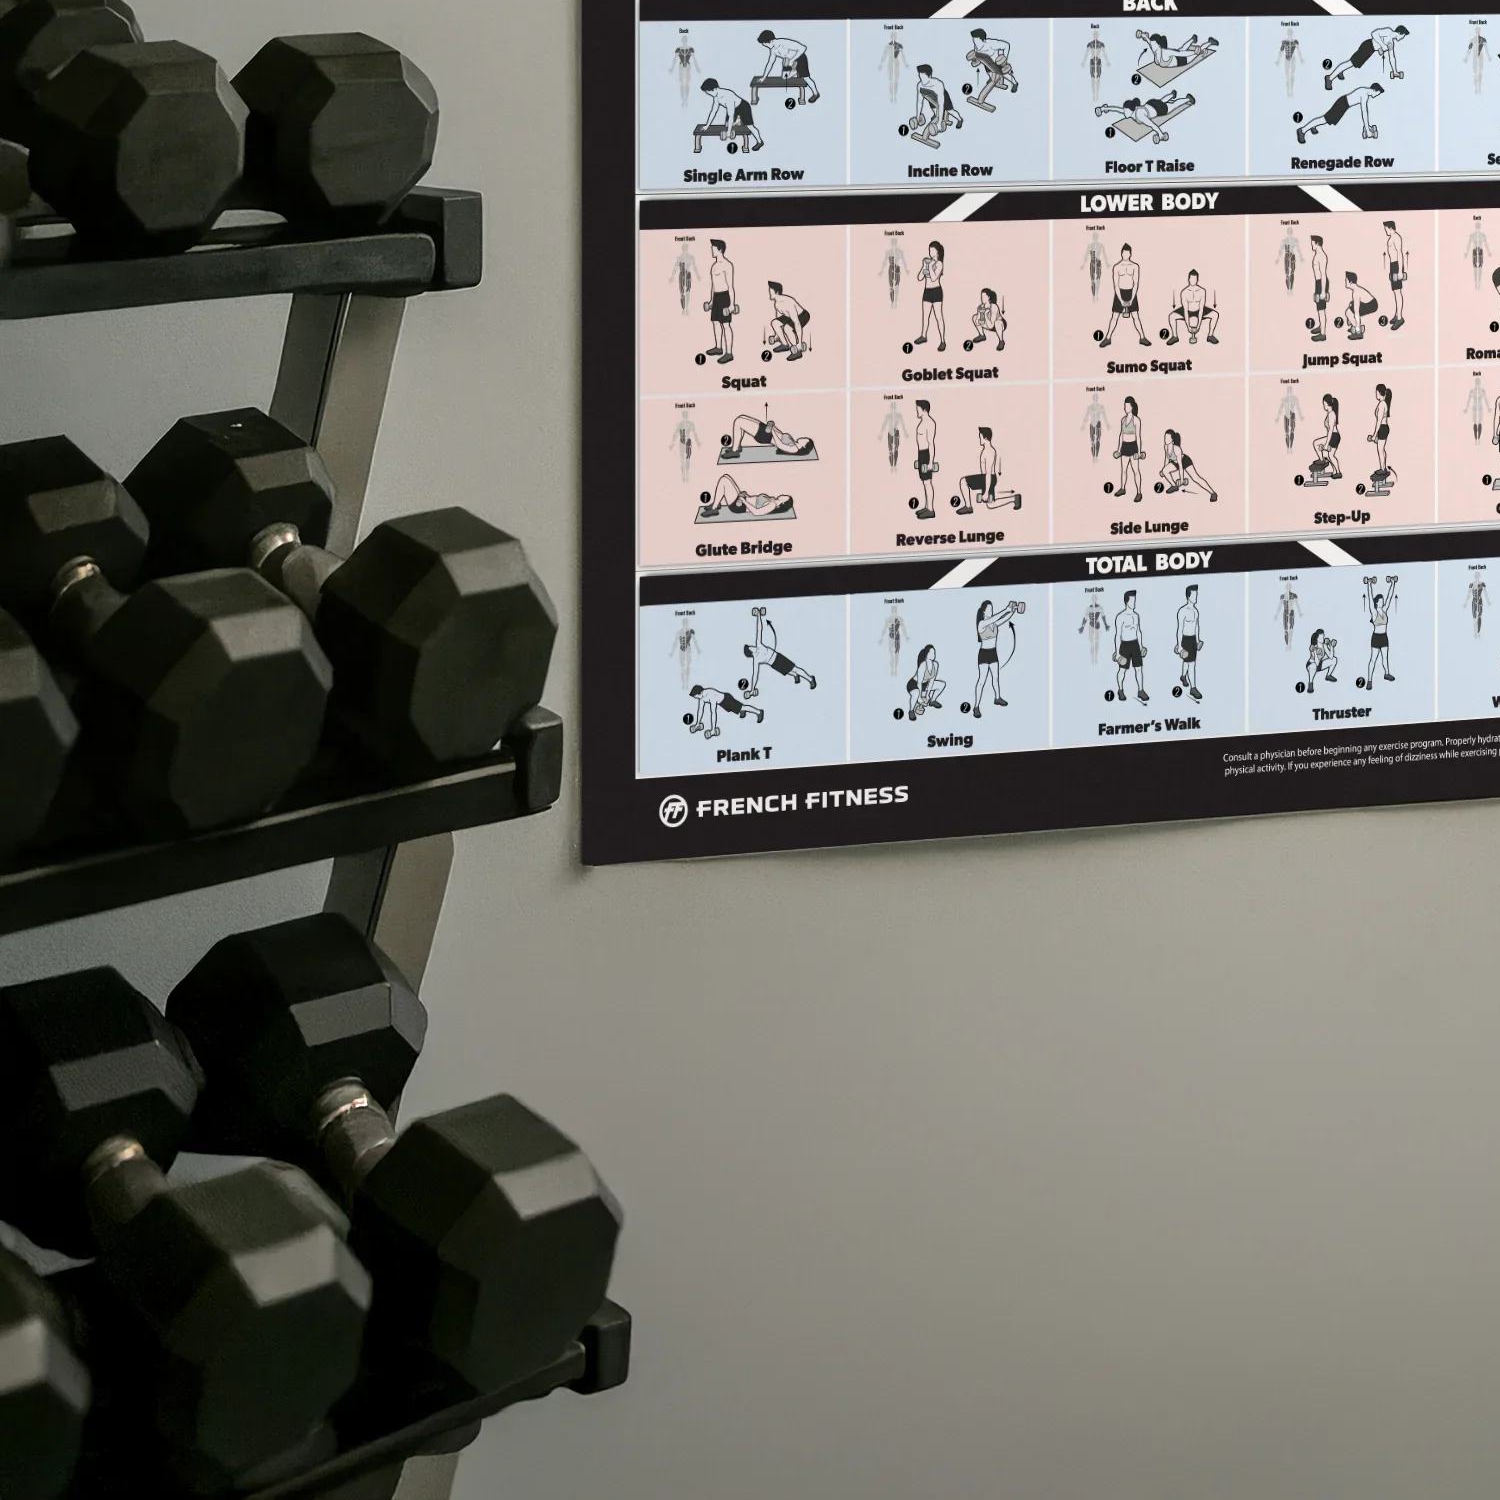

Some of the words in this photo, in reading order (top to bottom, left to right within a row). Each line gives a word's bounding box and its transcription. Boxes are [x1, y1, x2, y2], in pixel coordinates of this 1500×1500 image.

[908, 164, 958, 178] Incline
[961, 164, 993, 176] Row
[1105, 161, 1143, 173] Floor
[1145, 160, 1154, 172] T
[1156, 159, 1195, 172] Raise
[1291, 156, 1362, 171] Renegade
[1364, 155, 1395, 168] Row
[683, 168, 732, 185] Single
[735, 168, 768, 181] Arm
[771, 168, 805, 180] Row
[1081, 194, 1154, 212] LOWER
[1162, 192, 1219, 210] BODY
[1107, 361, 1148, 374] Sumo
[1150, 359, 1192, 374] Squat
[1302, 354, 1339, 369] Jump
[1342, 352, 1382, 367] Squat
[902, 368, 953, 382] Goblet
[955, 367, 999, 382] Squat
[722, 375, 767, 391] Squat
[1314, 510, 1371, 526] Step-Up
[1110, 521, 1142, 535] Side
[1145, 521, 1189, 535] Lunge
[896, 533, 956, 546] Reverse
[959, 530, 1005, 544] Lunge
[695, 544, 738, 557] Glute
[741, 540, 793, 556] Bridge
[1085, 554, 1147, 574] TOTAL
[1156, 551, 1213, 571] BODY
[1312, 706, 1372, 721] Thruster
[1164, 717, 1201, 731] Walk
[927, 733, 973, 748] Swing
[1223, 752, 1253, 762] Consult
[1260, 749, 1296, 761] physician
[1297, 747, 1322, 757] before
[1323, 745, 1362, 756] beginning
[1363, 744, 1378, 754] any
[1378, 741, 1409, 751] exercise
[1410, 739, 1444, 750] program.
[1445, 735, 1476, 747] Properly
[717, 748, 760, 763] Plank
[763, 746, 772, 759] T
[1224, 764, 1255, 777] physical
[1257, 763, 1286, 773] activity.
[1288, 760, 1293, 770] If
[1294, 762, 1309, 772] you
[1310, 758, 1352, 770] experience
[1353, 758, 1367, 767] any
[1368, 755, 1394, 765] feeling
[1395, 752, 1404, 762] of
[1404, 752, 1438, 762] dizziness
[1439, 749, 1459, 759] while
[1460, 747, 1497, 758] exercising
[696, 794, 797, 817] FRENCH
[805, 785, 908, 809] FITNESS
